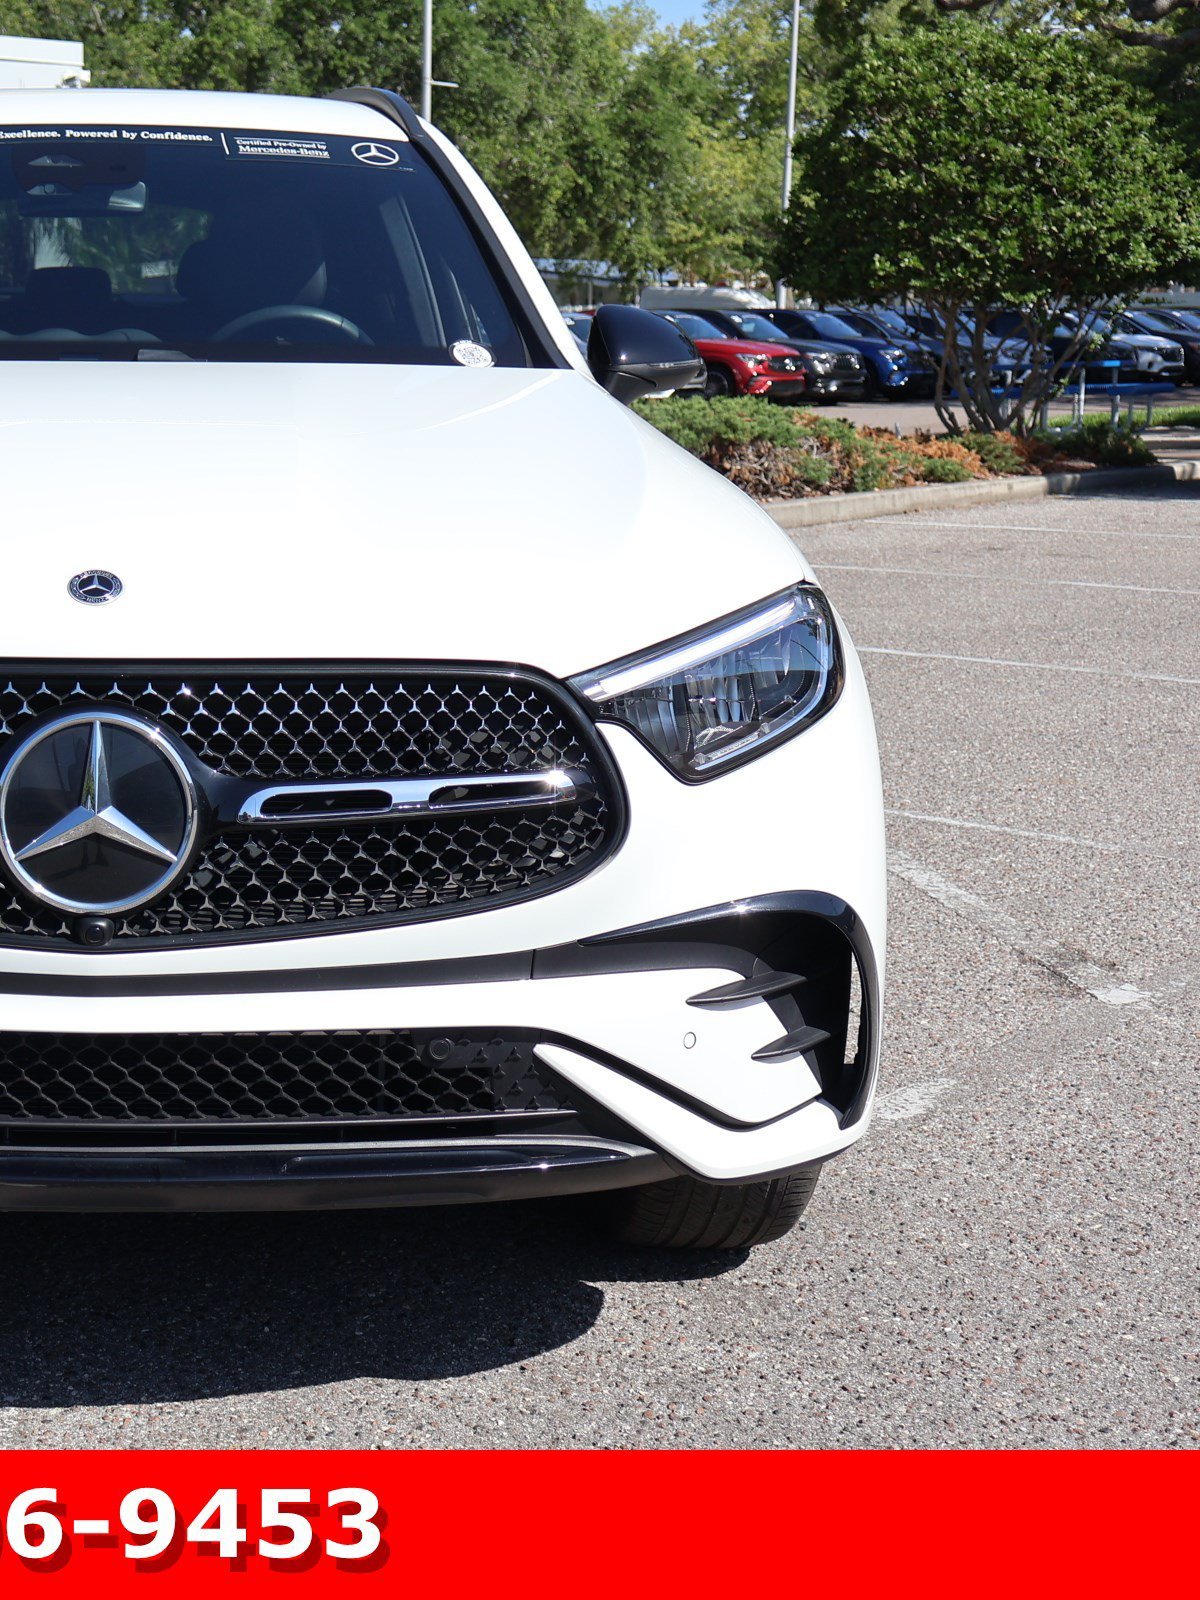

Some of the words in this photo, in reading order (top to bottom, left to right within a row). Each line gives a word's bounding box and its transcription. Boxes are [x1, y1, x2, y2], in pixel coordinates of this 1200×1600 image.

[65, 129, 118, 139] Powered
[122, 130, 137, 141] by
[140, 130, 213, 142] Confidence.
[236, 139, 272, 147] Certified
[273, 141, 317, 149] Pre-Owned
[238, 145, 330, 157] Mercedes-Benz
